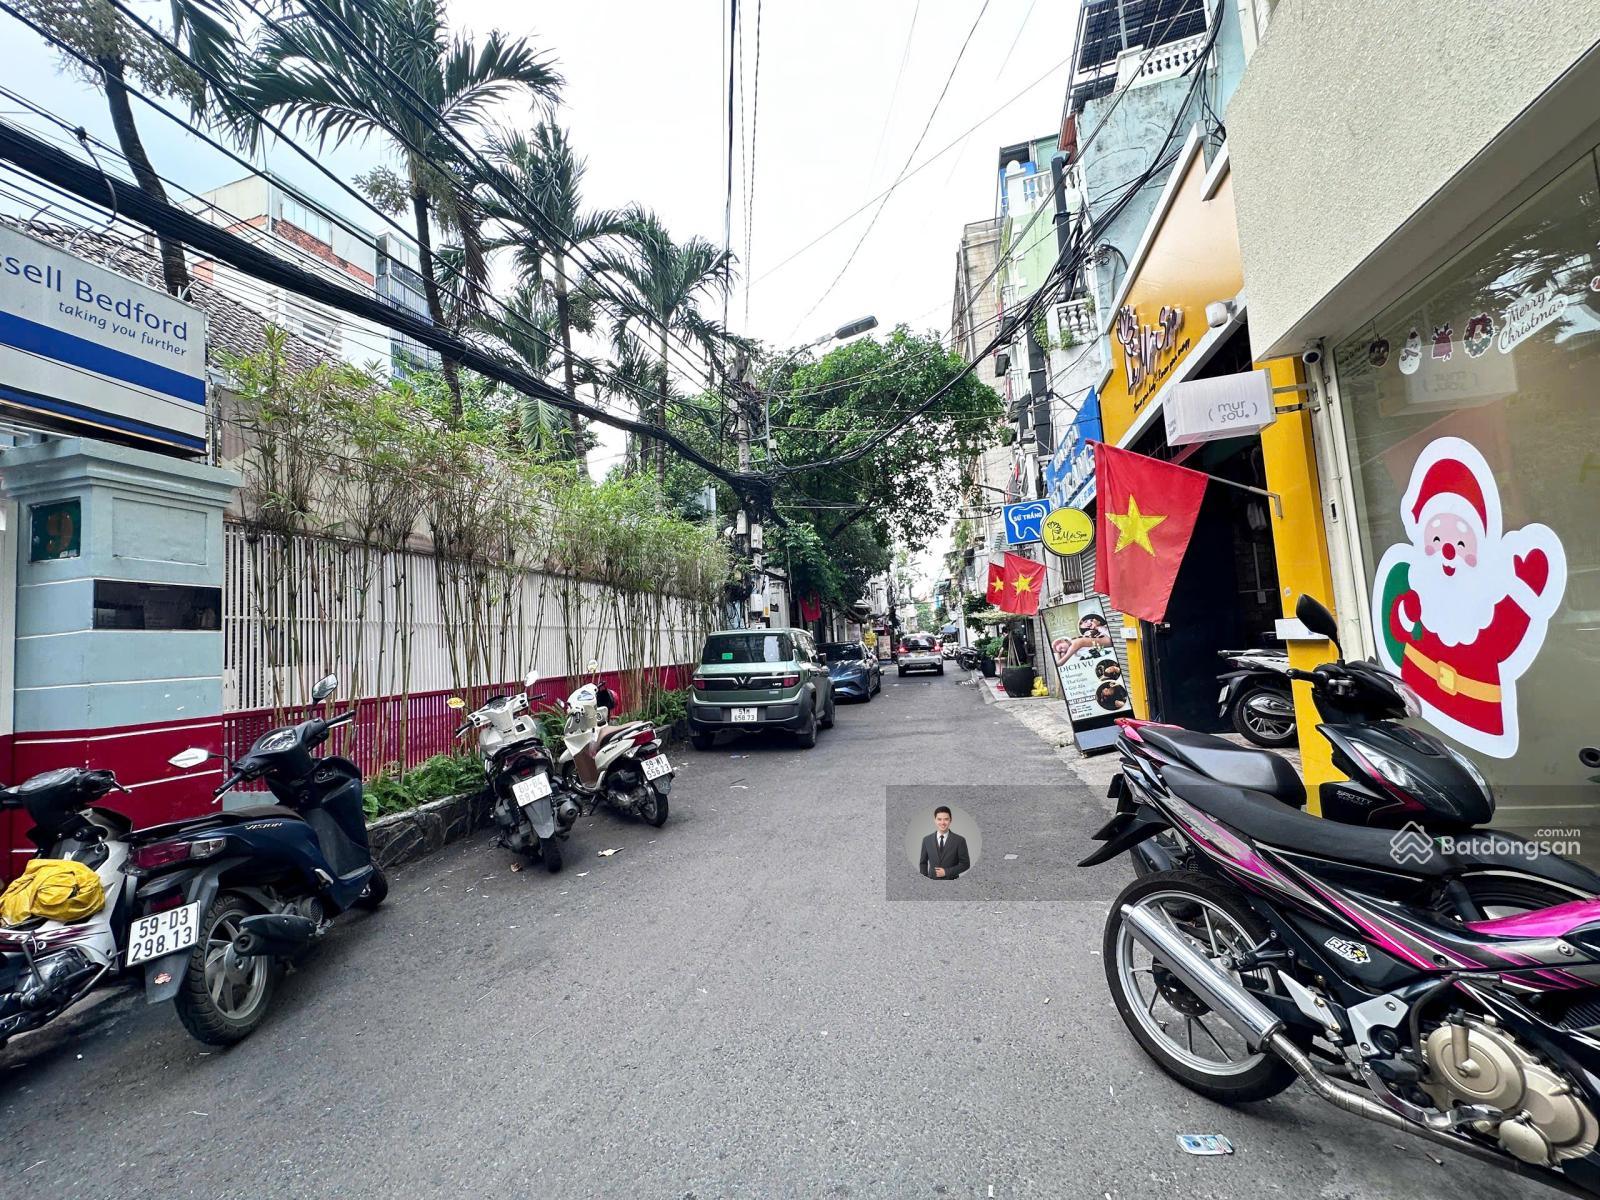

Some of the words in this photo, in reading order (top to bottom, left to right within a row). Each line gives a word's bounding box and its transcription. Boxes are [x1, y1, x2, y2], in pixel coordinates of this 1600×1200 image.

[0, 255, 61, 292] sell
[75, 279, 188, 341] Bedford
[1509, 292, 1545, 324] Merry
[59, 301, 107, 329] taking
[112, 323, 136, 339] you
[141, 332, 187, 357] further
[1501, 300, 1564, 350] Christmas
[1217, 400, 1245, 413] mur
[138, 907, 189, 939] 59-D3
[132, 927, 192, 963] 298.13
